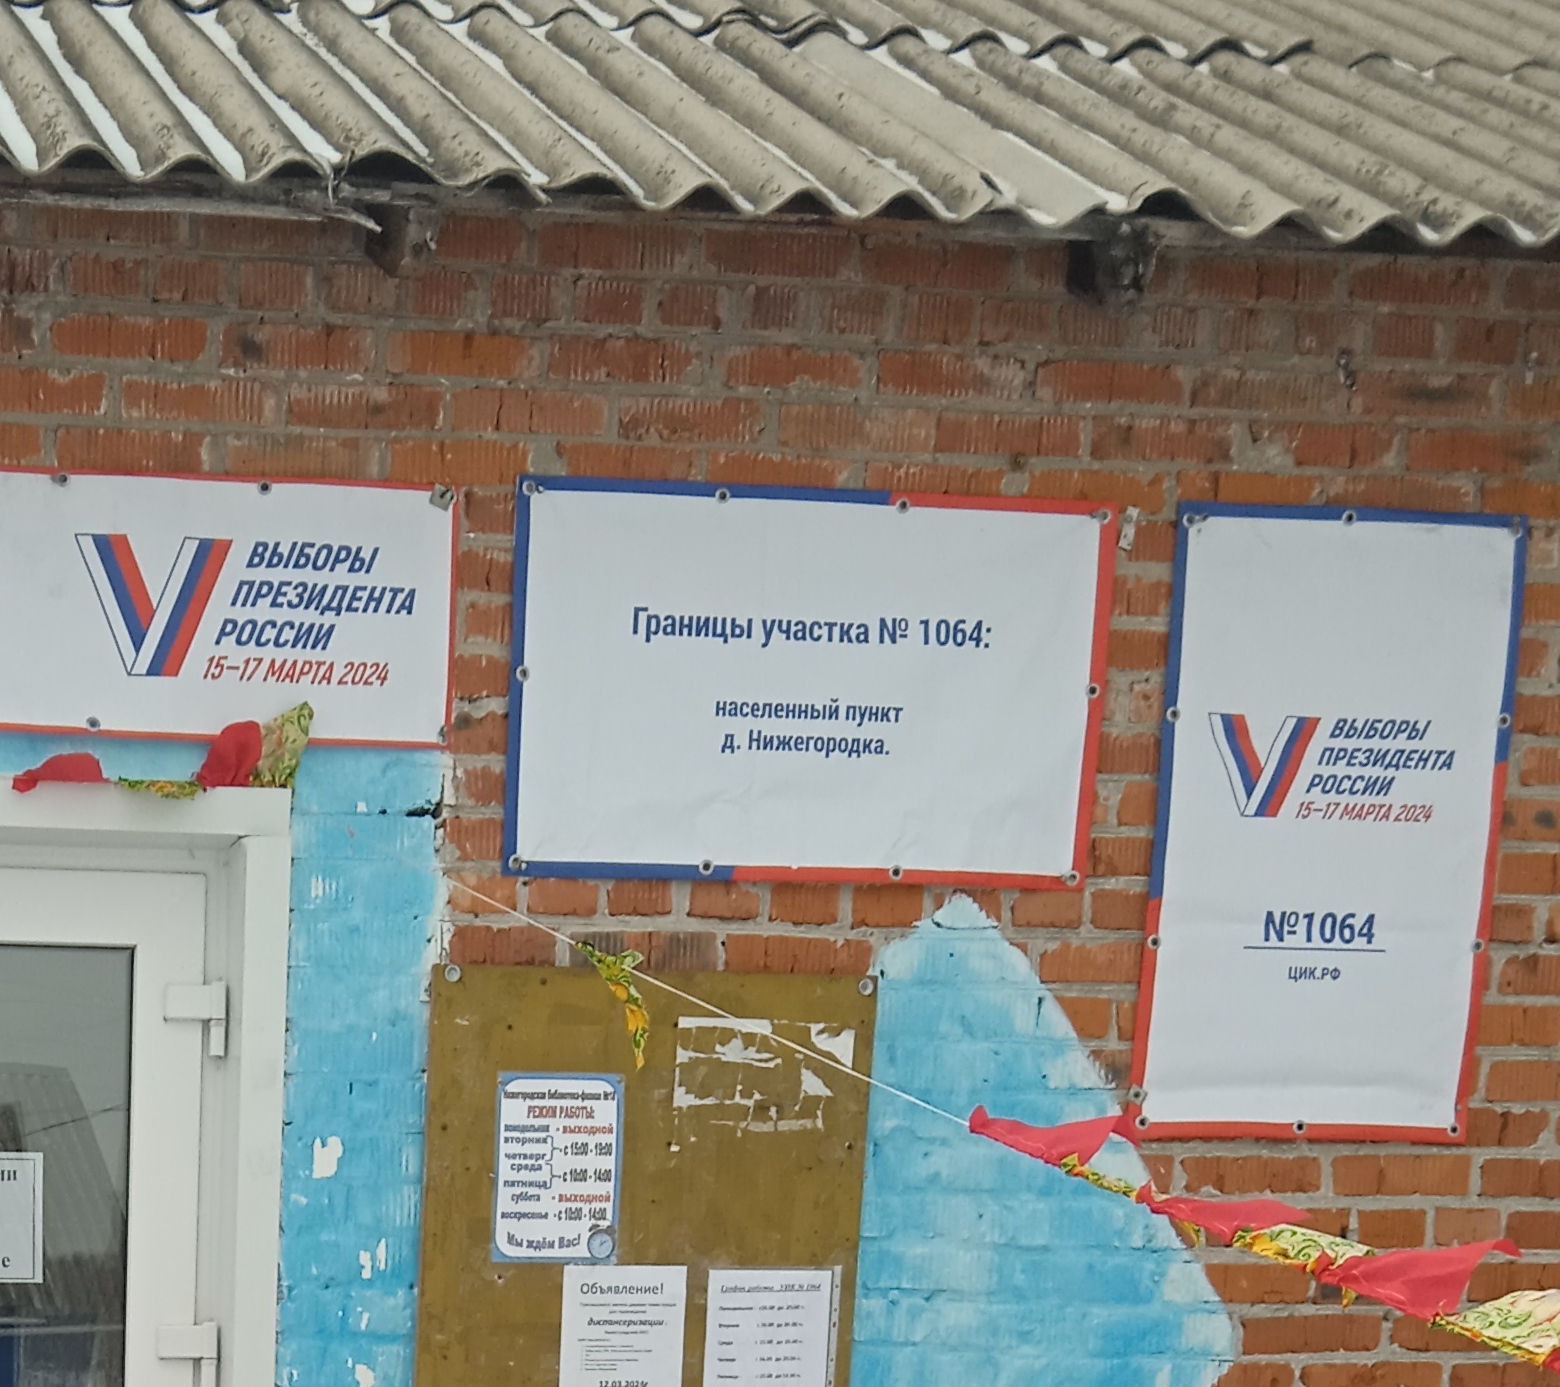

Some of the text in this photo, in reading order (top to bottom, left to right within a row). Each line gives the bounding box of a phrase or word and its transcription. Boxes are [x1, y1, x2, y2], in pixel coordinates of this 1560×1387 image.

[245, 540, 380, 574] ВЫБОРЫ
[230, 579, 417, 617] ПРЕЗИДЕНТА
[214, 617, 336, 651] РОССИИ
[631, 606, 992, 649] Границы участка № 1064:
[263, 658, 335, 686] МАРТА
[337, 661, 389, 687] 2024
[715, 697, 904, 727] населенный пункт
[1328, 717, 1432, 741] ВЫБОРЫ
[720, 728, 890, 759] д. Нижегородка.
[1317, 747, 1456, 771] ПРЕЗИДЕНТА
[1305, 773, 1396, 797] РОССИИ
[1339, 802, 1391, 822] МАРТА
[1393, 804, 1434, 823] 2024
[1263, 910, 1376, 945] №1064
[1288, 965, 1341, 983] ЦИК.РФ
[526, 1105, 558, 1119] РЕЖИМ
[562, 1123, 614, 1136] выходной
[504, 1152, 547, 1162] четверг
[510, 1162, 543, 1173] среда
[558, 1190, 611, 1205] выходной
[580, 1282, 664, 1295] Объявление!
